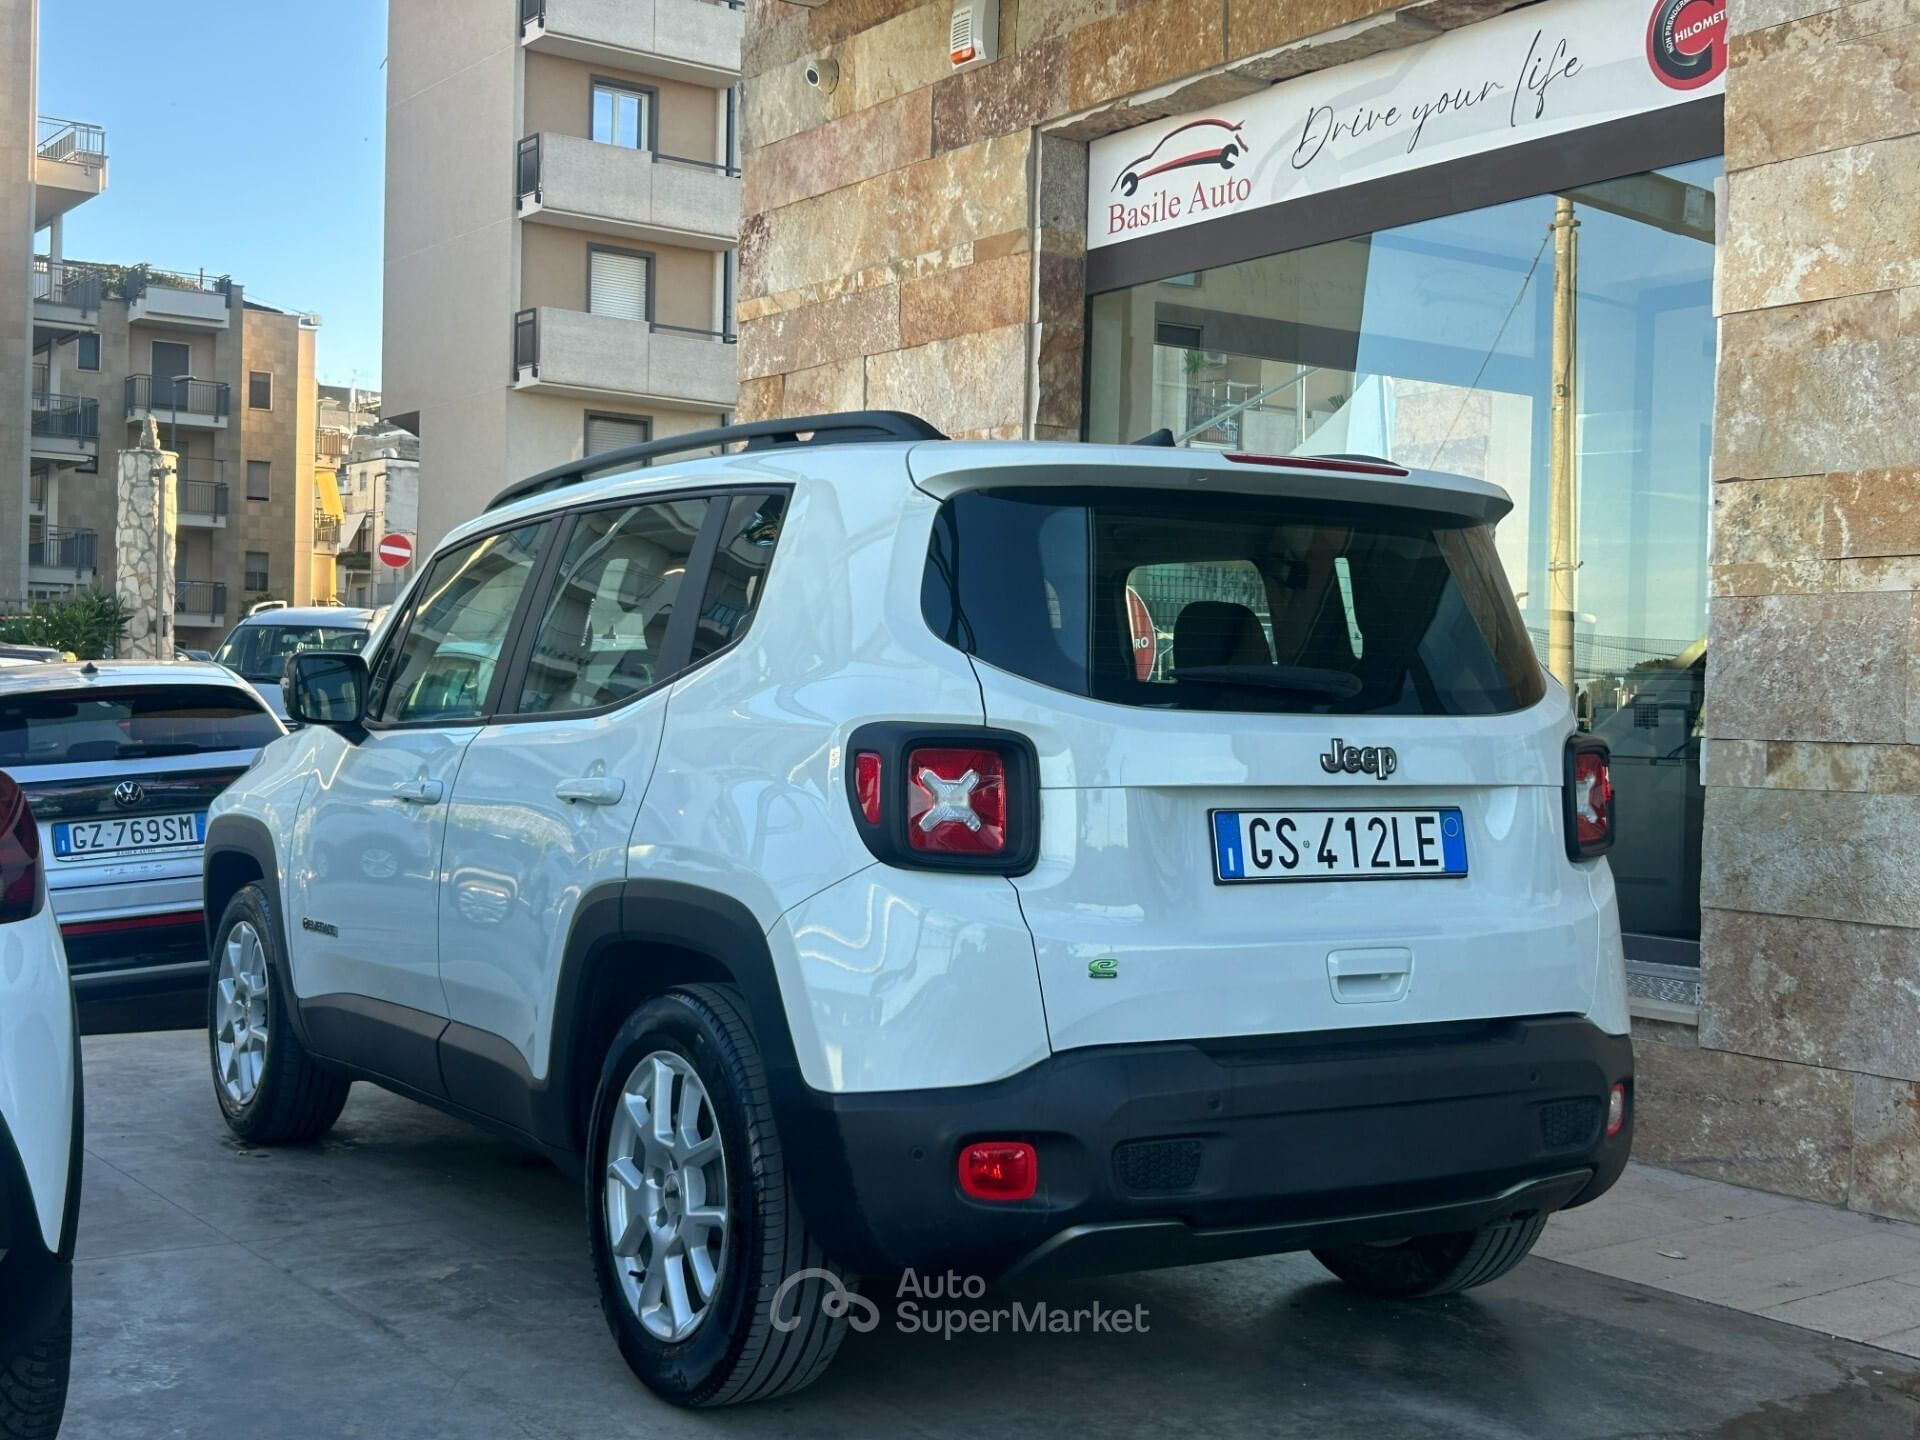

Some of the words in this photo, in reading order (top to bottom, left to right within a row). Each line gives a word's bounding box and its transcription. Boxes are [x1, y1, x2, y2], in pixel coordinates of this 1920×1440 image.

[1674, 9, 1727, 44] HILOMET
[1291, 105, 1402, 170] Drive
[1407, 80, 1504, 154] your
[1509, 29, 1584, 128] life
[1107, 189, 1181, 235] Basile
[1187, 175, 1252, 215] Auto
[1134, 636, 1150, 650] RO
[1319, 738, 1398, 781] Jeep
